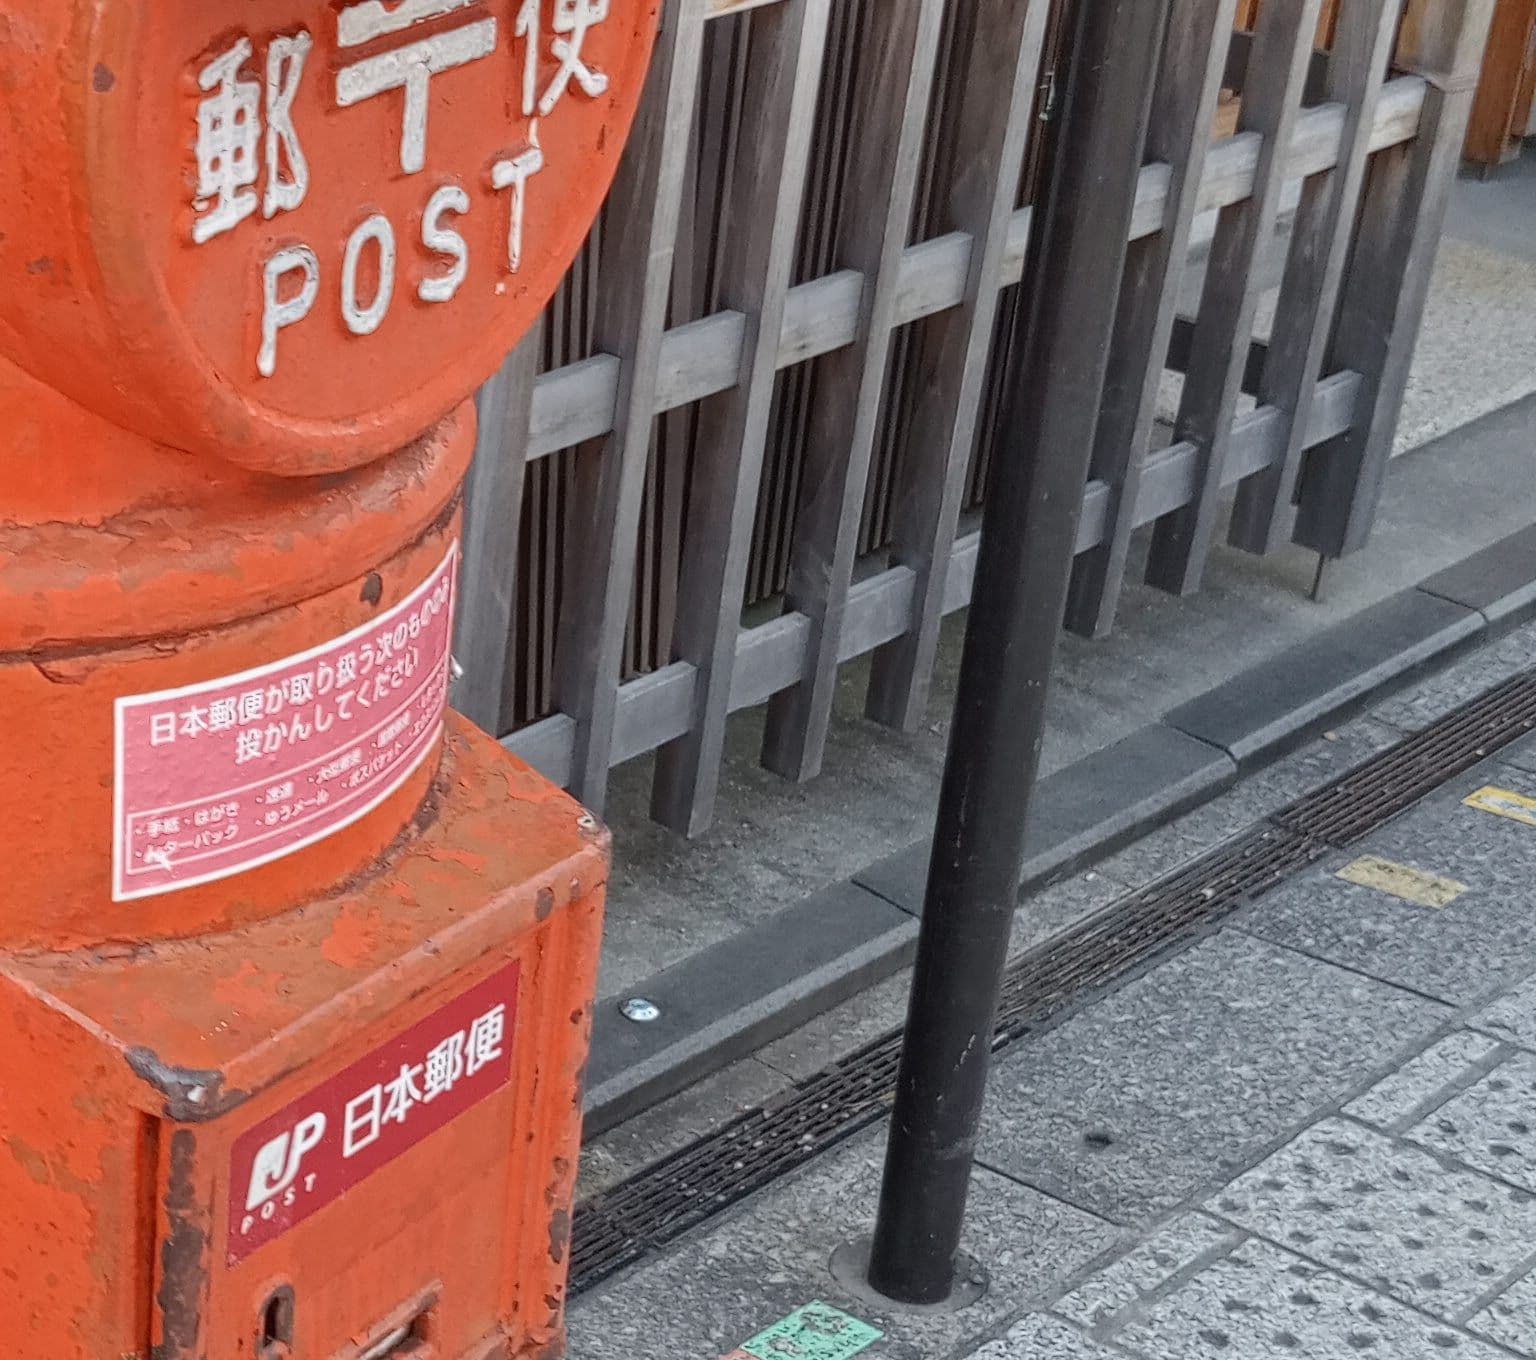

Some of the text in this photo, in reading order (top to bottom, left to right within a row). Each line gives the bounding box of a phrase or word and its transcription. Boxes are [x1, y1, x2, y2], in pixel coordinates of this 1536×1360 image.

[257, 146, 544, 377] POST
[235, 645, 420, 764] 投かんしてください
[342, 1003, 507, 1158] 日本郵便
[240, 1172, 317, 1236] POST
